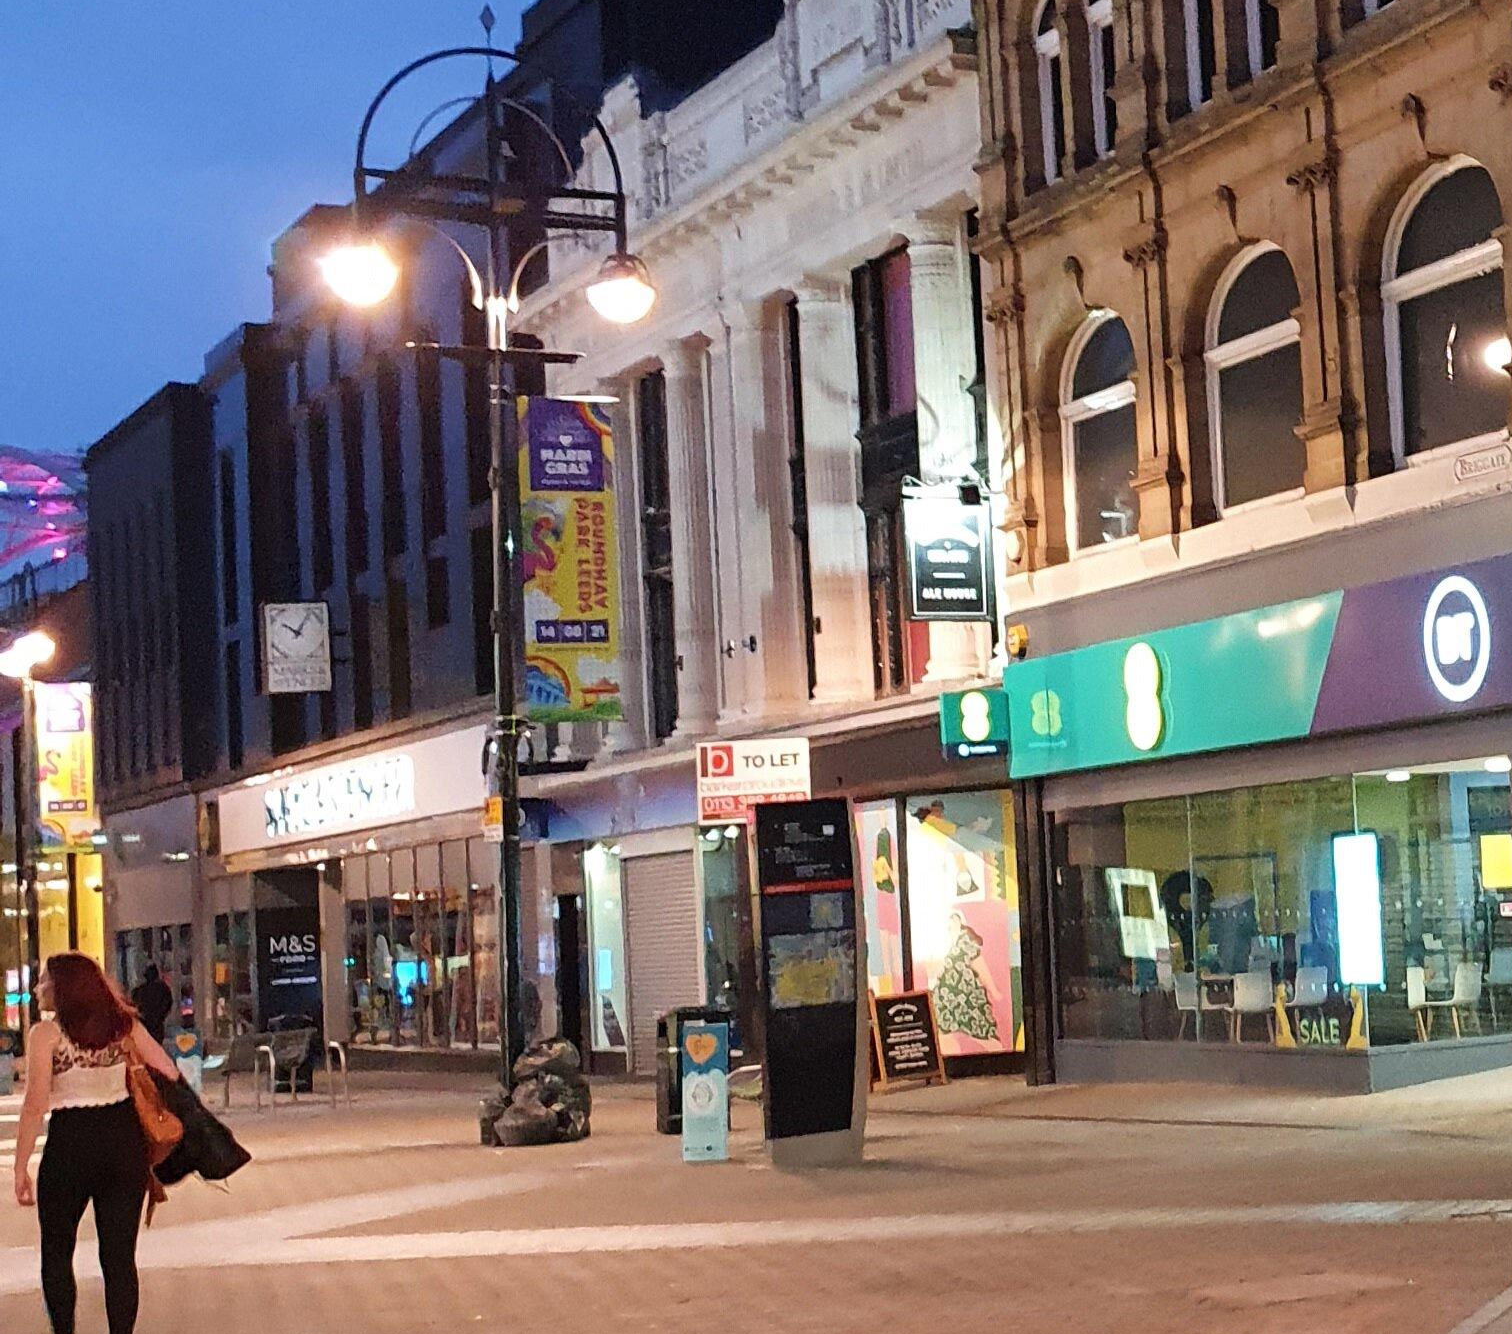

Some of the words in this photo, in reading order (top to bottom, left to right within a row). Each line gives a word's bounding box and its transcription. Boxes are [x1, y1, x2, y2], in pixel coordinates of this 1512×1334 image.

[574, 497, 591, 548] PARK
[592, 501, 608, 609] ROUNDHAY
[577, 558, 593, 614] LEEDS
[742, 755, 765, 768] TO
[770, 753, 800, 767] LET
[704, 796, 735, 813] 0113
[269, 934, 316, 955] M&S
[1300, 1018, 1340, 1044] SALE
